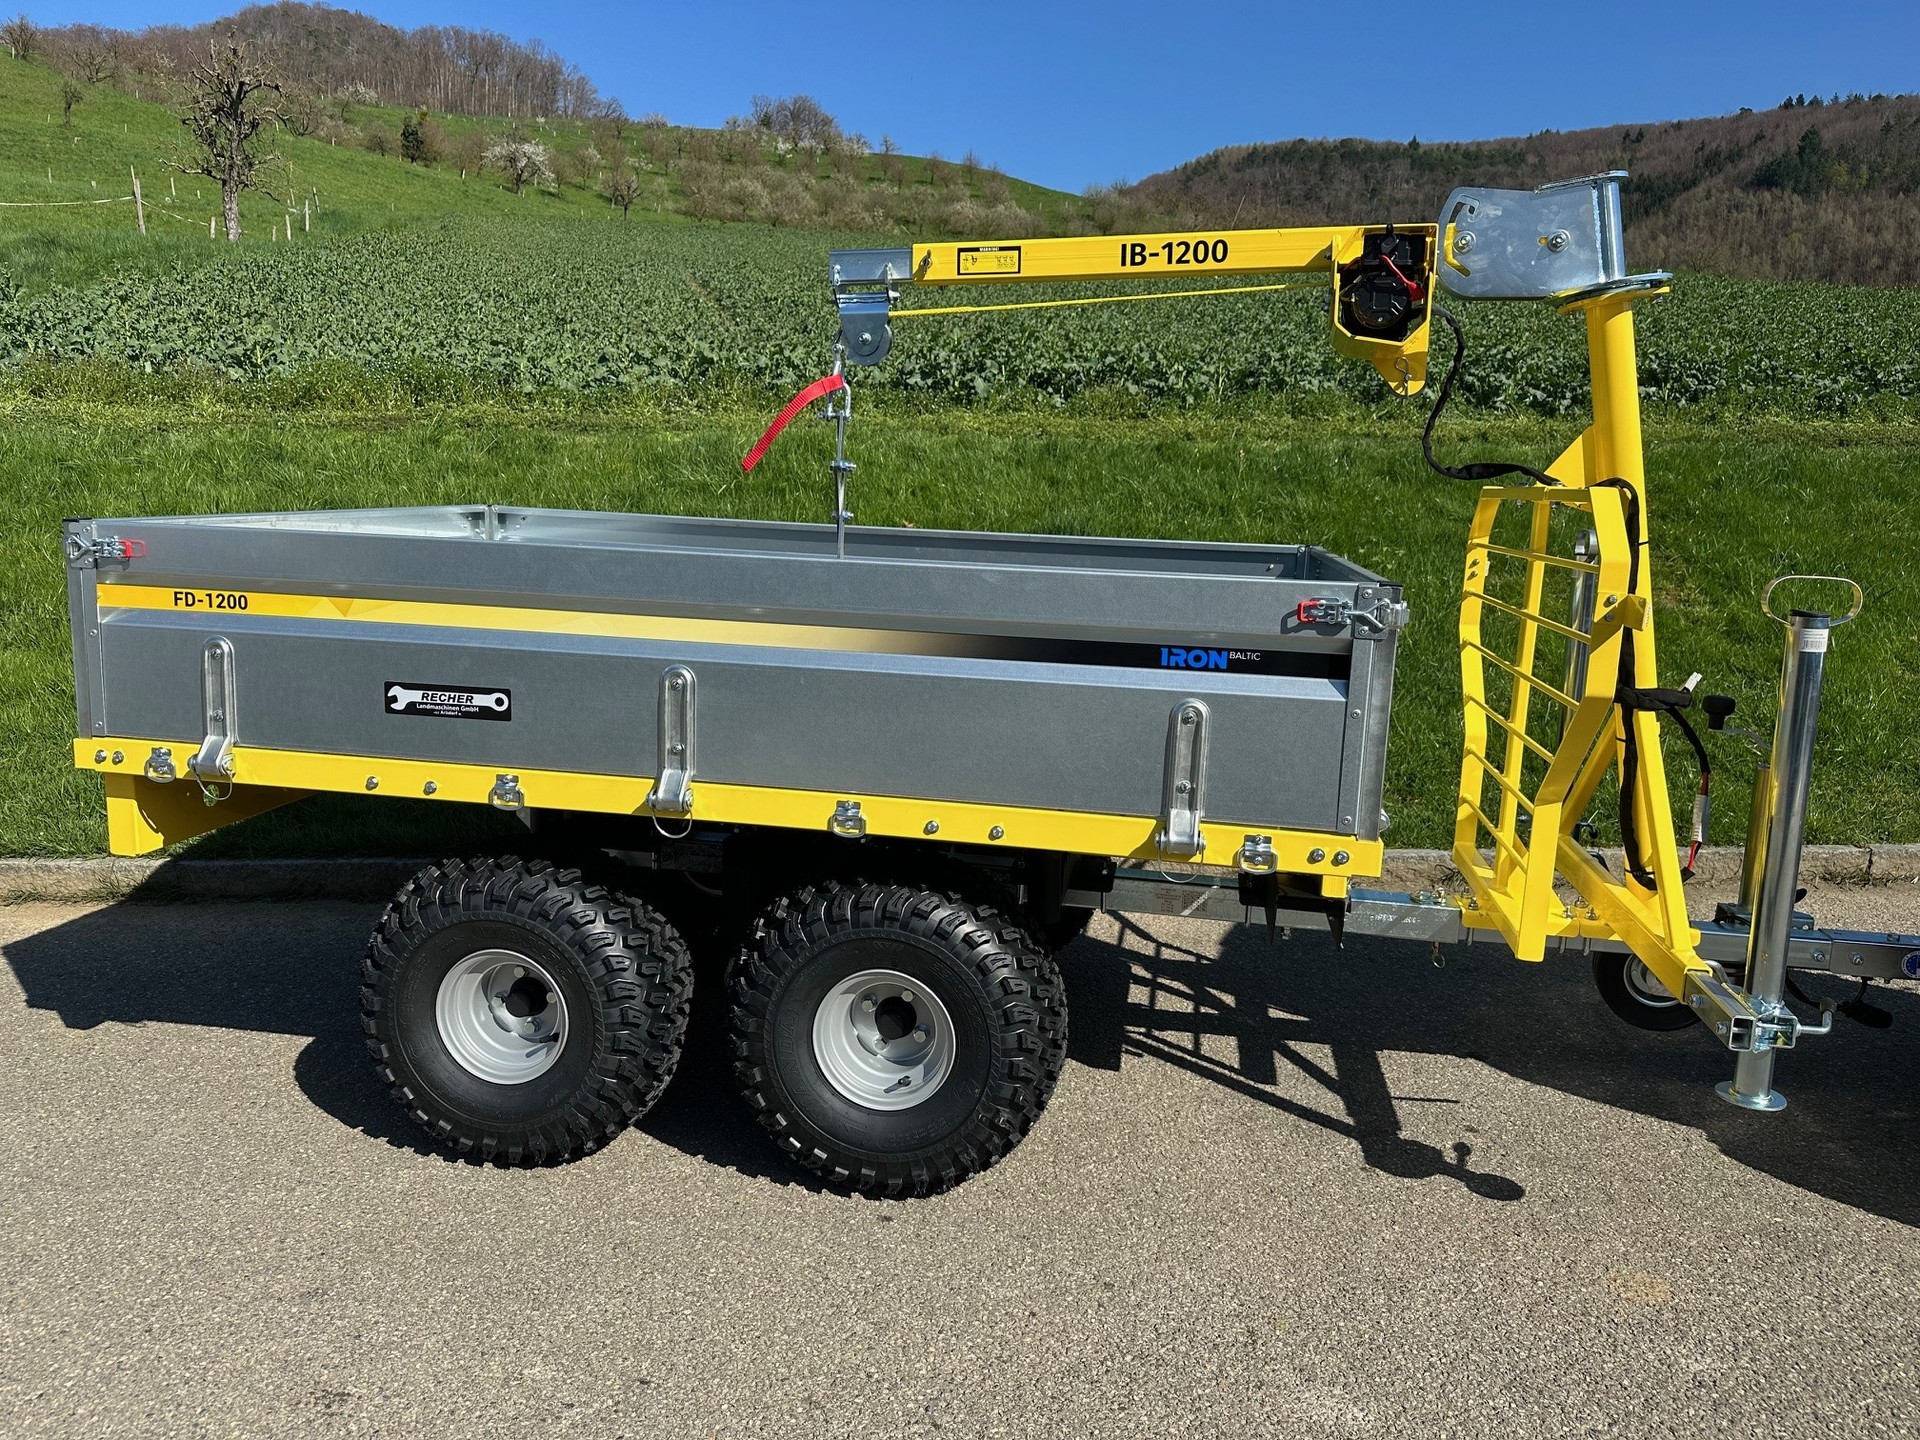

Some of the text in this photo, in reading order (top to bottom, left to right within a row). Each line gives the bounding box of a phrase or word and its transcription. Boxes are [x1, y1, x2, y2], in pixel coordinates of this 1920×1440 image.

[1120, 239, 1229, 267] IB-1200
[173, 591, 249, 611] FD-1200
[1160, 647, 1261, 670] IRON BALTIC
[416, 703, 460, 711] Landmaschinen
[421, 692, 474, 704] RECHER
